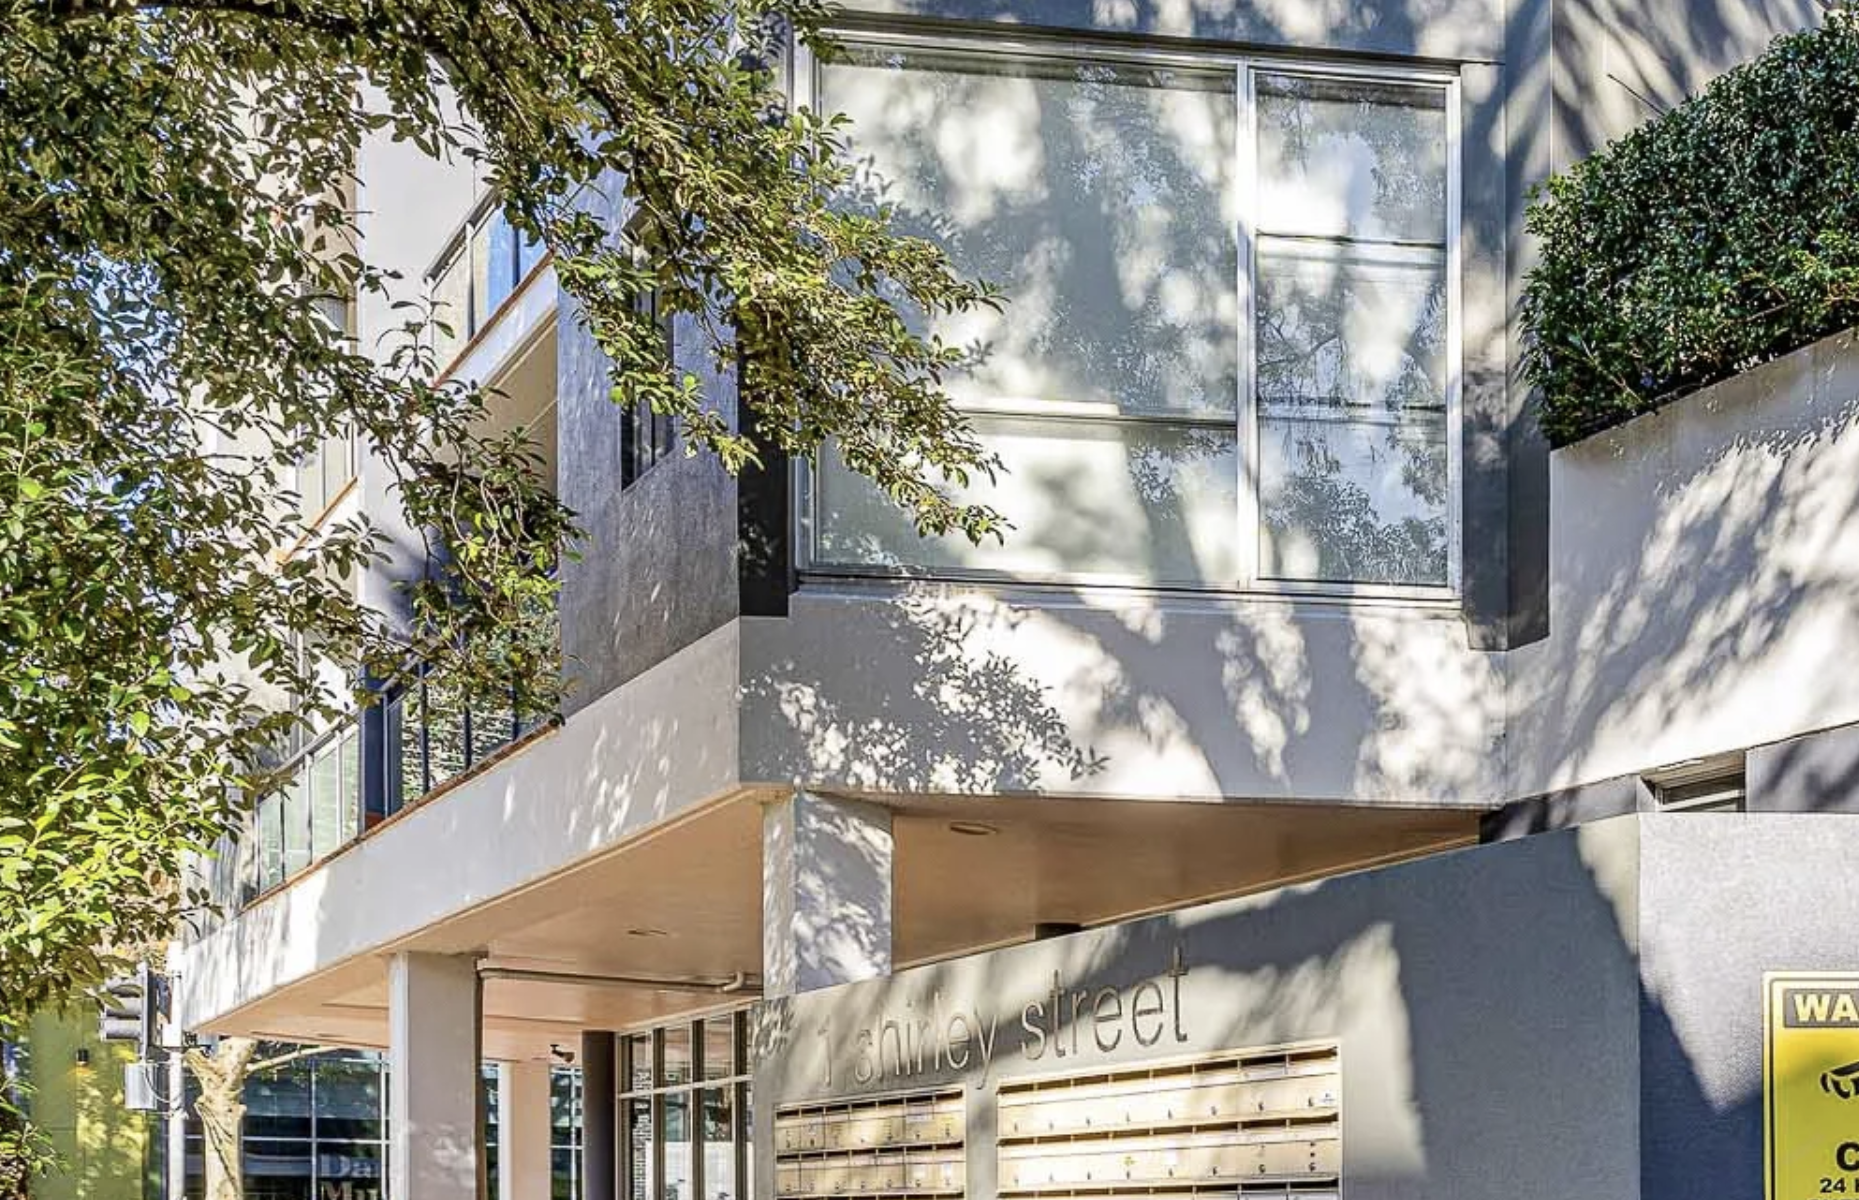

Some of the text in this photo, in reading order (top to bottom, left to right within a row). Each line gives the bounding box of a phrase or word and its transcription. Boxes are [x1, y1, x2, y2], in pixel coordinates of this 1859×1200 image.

[853, 994, 998, 1090] shirley
[1022, 947, 1188, 1060] street
[1820, 1178, 1846, 1193] 24
